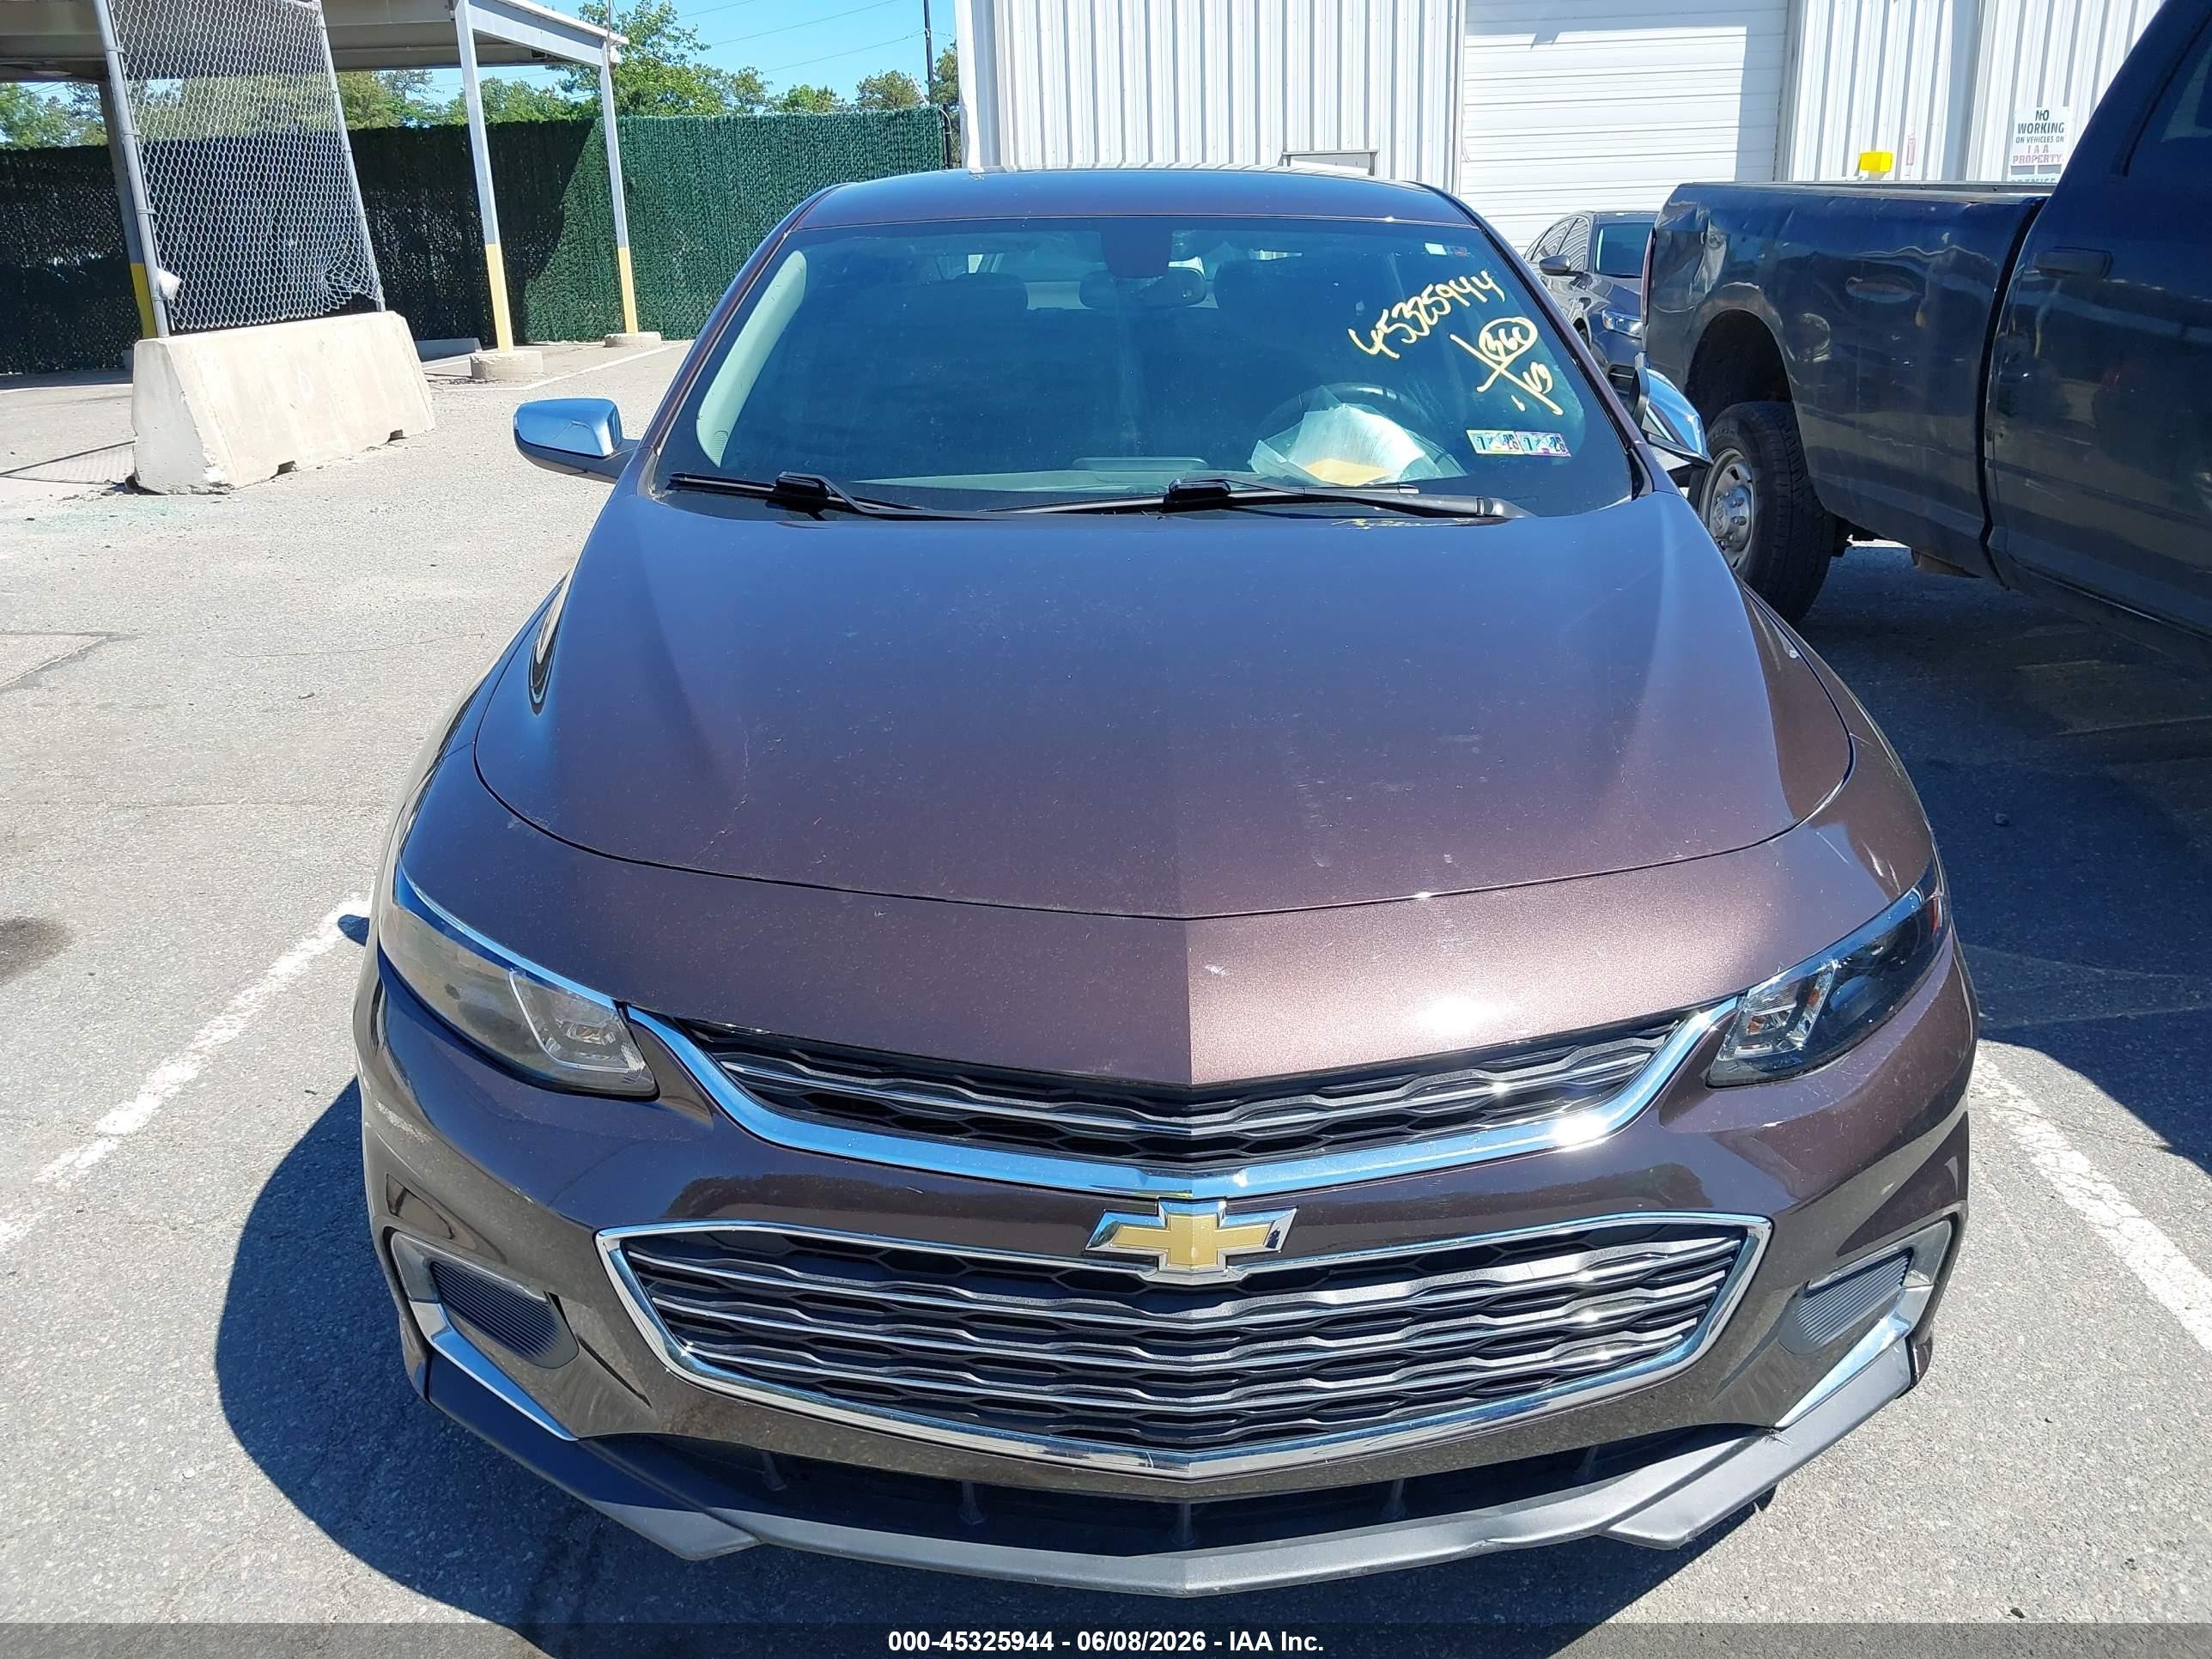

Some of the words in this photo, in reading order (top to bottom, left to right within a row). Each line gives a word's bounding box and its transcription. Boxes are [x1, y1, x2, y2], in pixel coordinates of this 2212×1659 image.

[2035, 110, 2050, 121] NO
[2017, 123, 2065, 134] WORKING
[1347, 270, 1505, 359] 45325944
